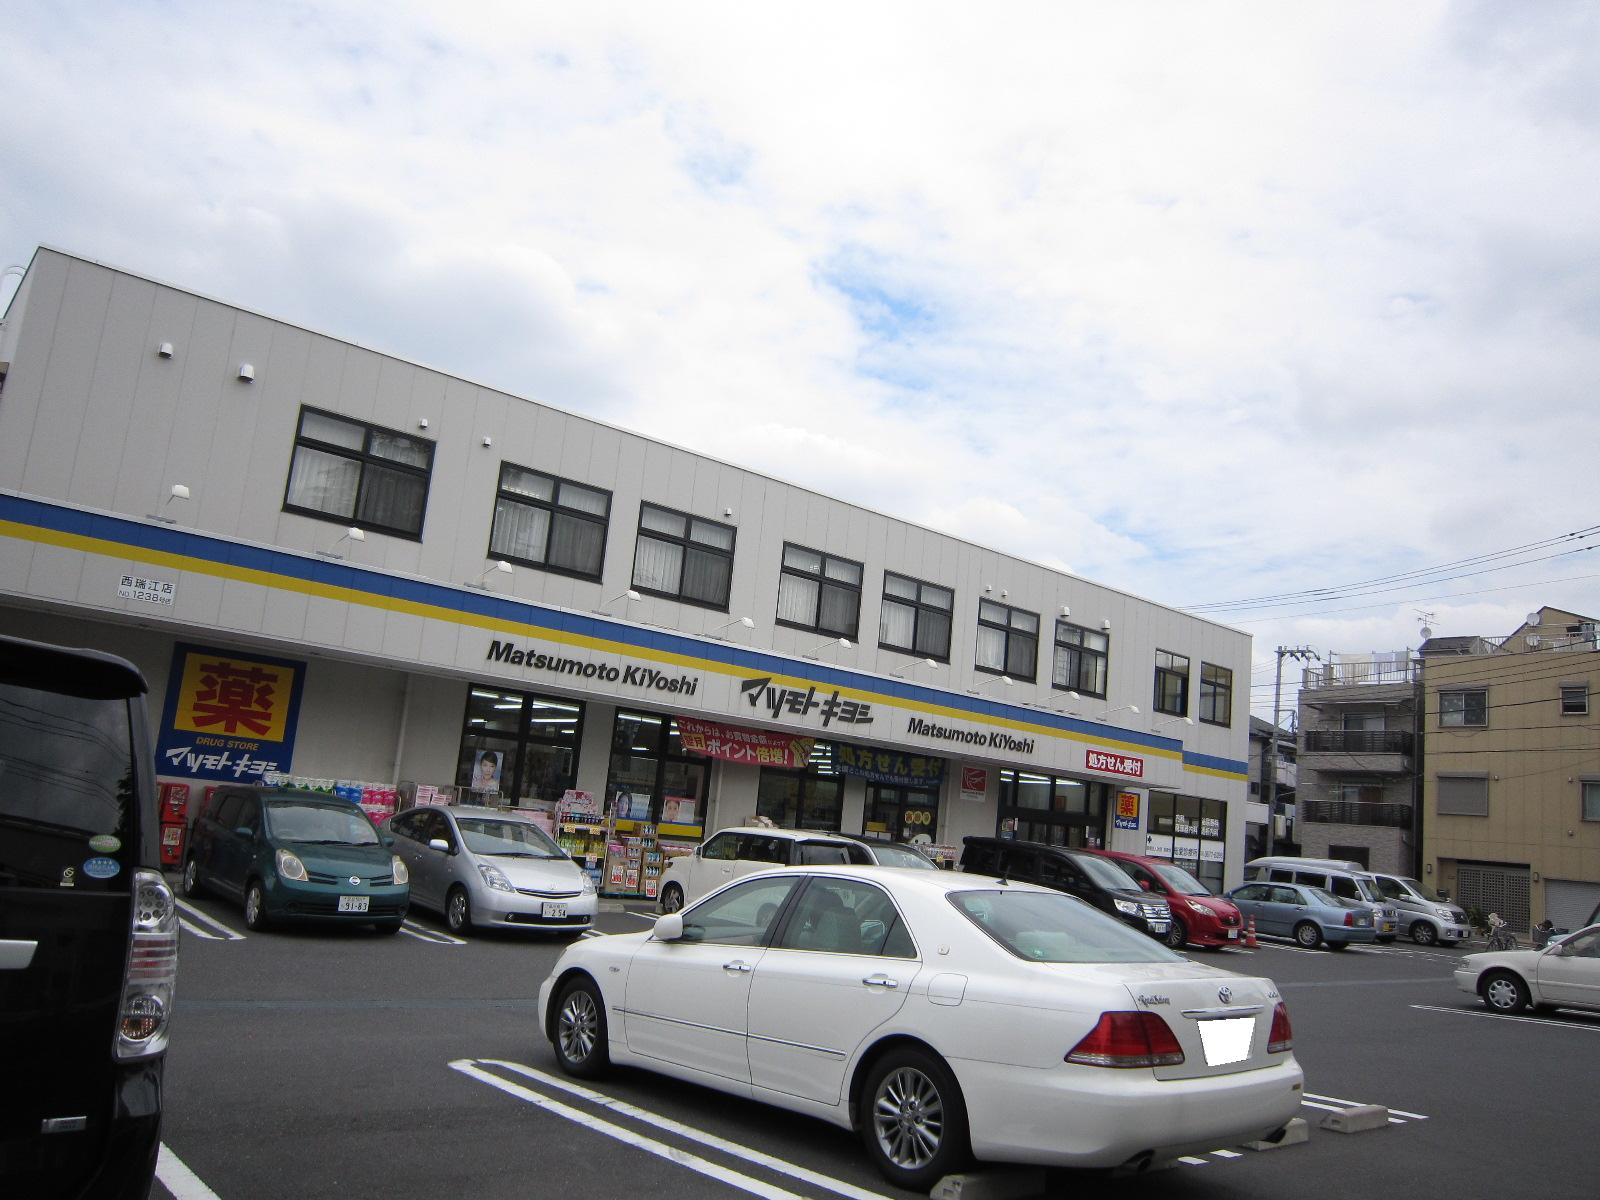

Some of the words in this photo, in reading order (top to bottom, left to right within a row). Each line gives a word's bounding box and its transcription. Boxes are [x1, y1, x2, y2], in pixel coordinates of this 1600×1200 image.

[121, 575, 173, 594] 西瑞江店
[487, 640, 620, 682] Matsumoto
[622, 665, 699, 696] KiYoshi
[192, 662, 278, 736] 薬
[741, 677, 874, 727] マツモトキヨシ
[196, 737, 225, 747] DRUG
[227, 740, 259, 750] STORE
[907, 717, 987, 746] Matsumoto
[988, 732, 1035, 754] KiYoshi
[165, 747, 280, 777] マツモトキヨシ
[1088, 752, 1141, 775] 処方せん受付
[1120, 794, 1135, 815] 薬
